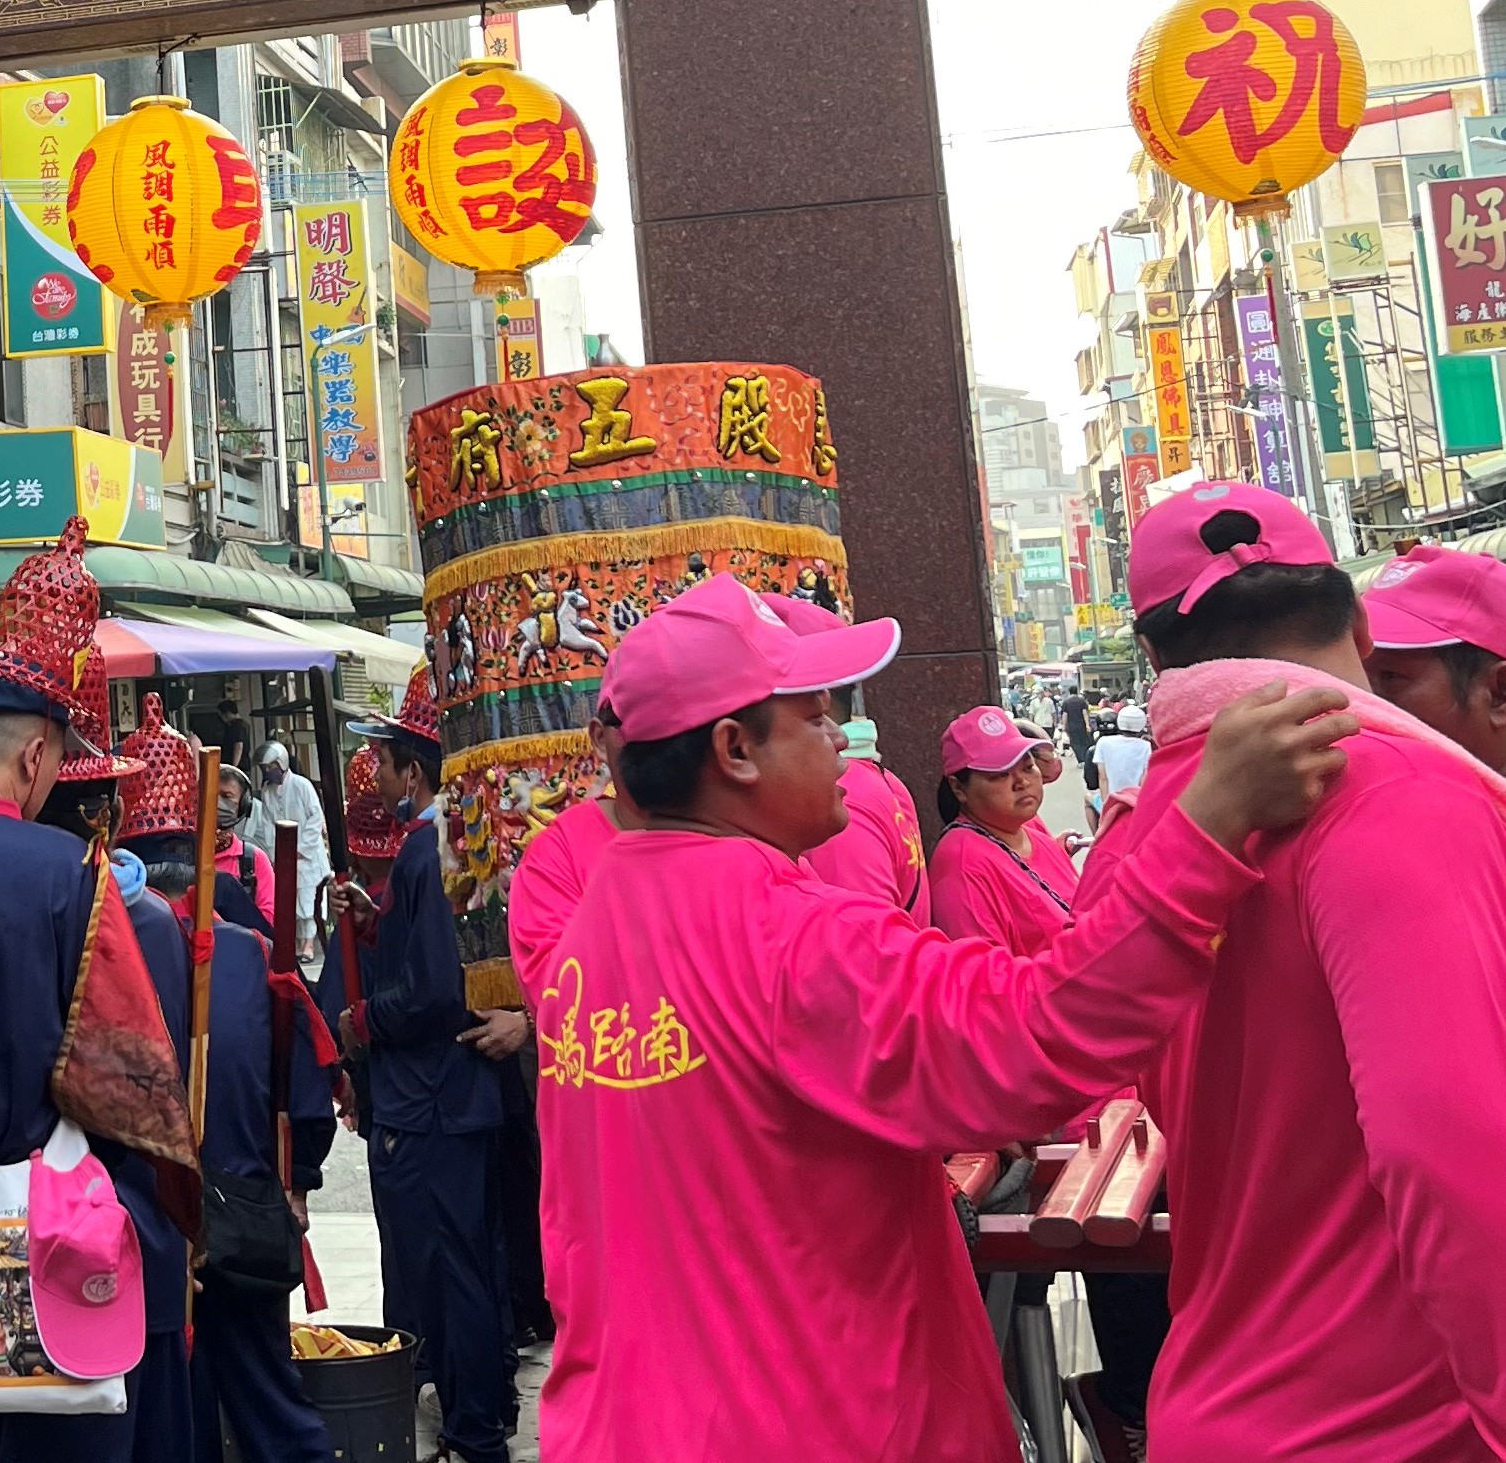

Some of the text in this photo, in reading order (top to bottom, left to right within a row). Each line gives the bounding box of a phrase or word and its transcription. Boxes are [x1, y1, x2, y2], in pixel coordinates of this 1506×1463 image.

[1179, 0, 1356, 164] 祝
[39, 135, 62, 227] 公益彩券
[142, 139, 177, 270] 風調雨順
[305, 211, 360, 306] 明聲
[510, 350, 532, 378] 彰
